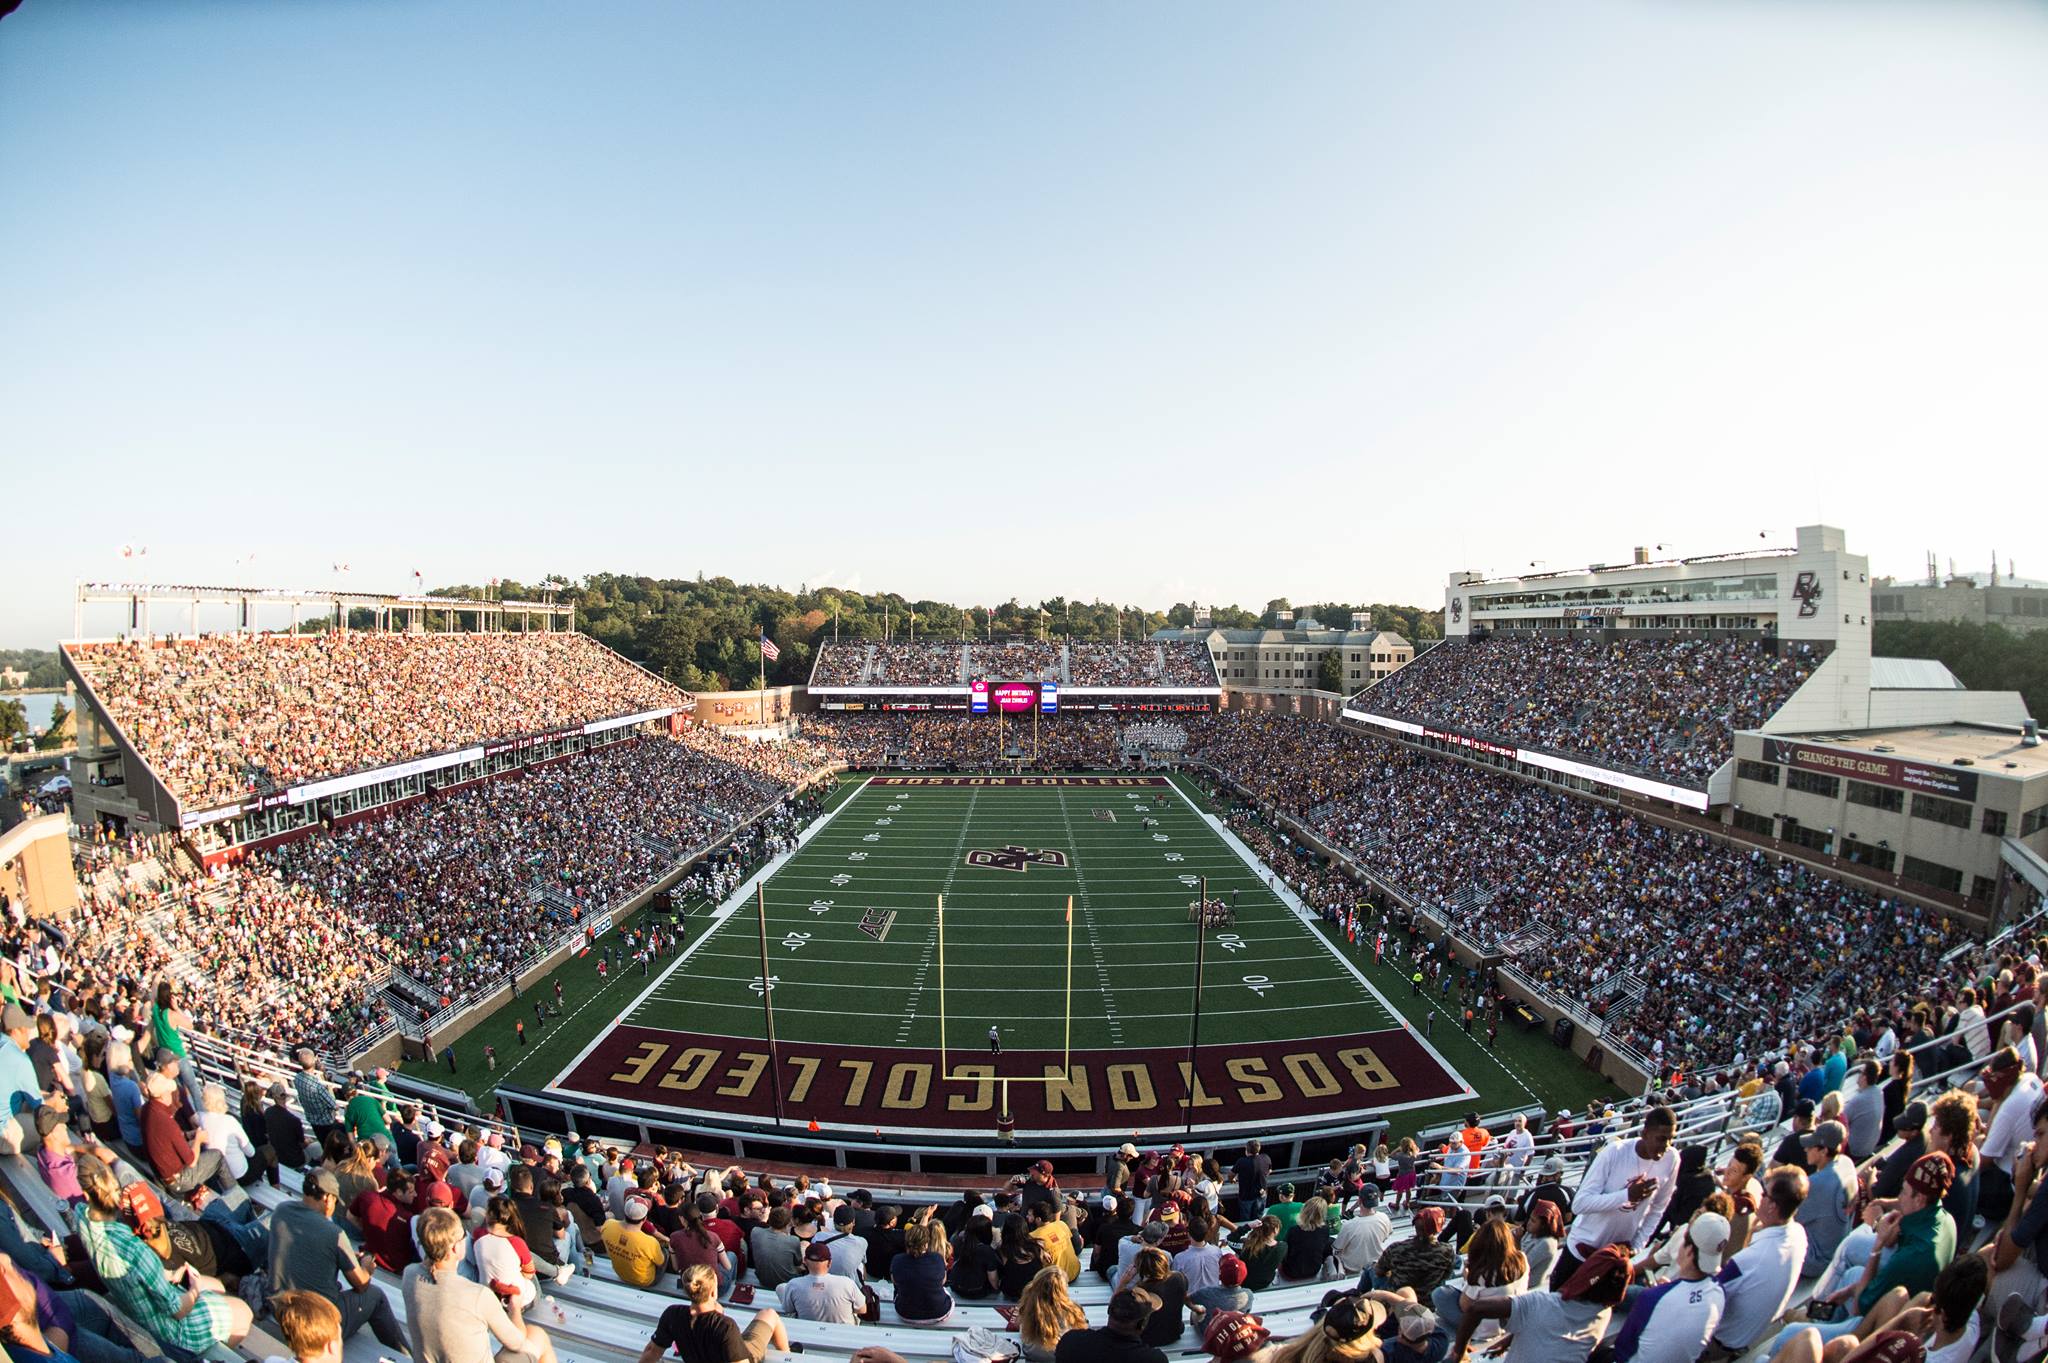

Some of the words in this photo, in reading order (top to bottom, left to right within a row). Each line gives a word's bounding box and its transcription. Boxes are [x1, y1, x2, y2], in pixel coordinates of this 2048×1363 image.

[1592, 606, 1625, 616] COLLEGE
[1796, 750, 1837, 766] CHANGE
[1837, 757, 1856, 770] THE
[1857, 761, 1890, 776] GAME.
[808, 899, 835, 912] 30
[594, 918, 611, 936] EICO
[857, 907, 890, 939] ACC
[781, 931, 812, 947] 20
[1216, 933, 1247, 949] 20
[748, 975, 780, 991] 10
[1242, 975, 1274, 991] 10
[610, 1041, 994, 1111] COLLEGE
[1044, 1047, 1400, 1112] BOSTON
[1689, 1289, 1703, 1304] 25
[1229, 1319, 1242, 1331] TO
